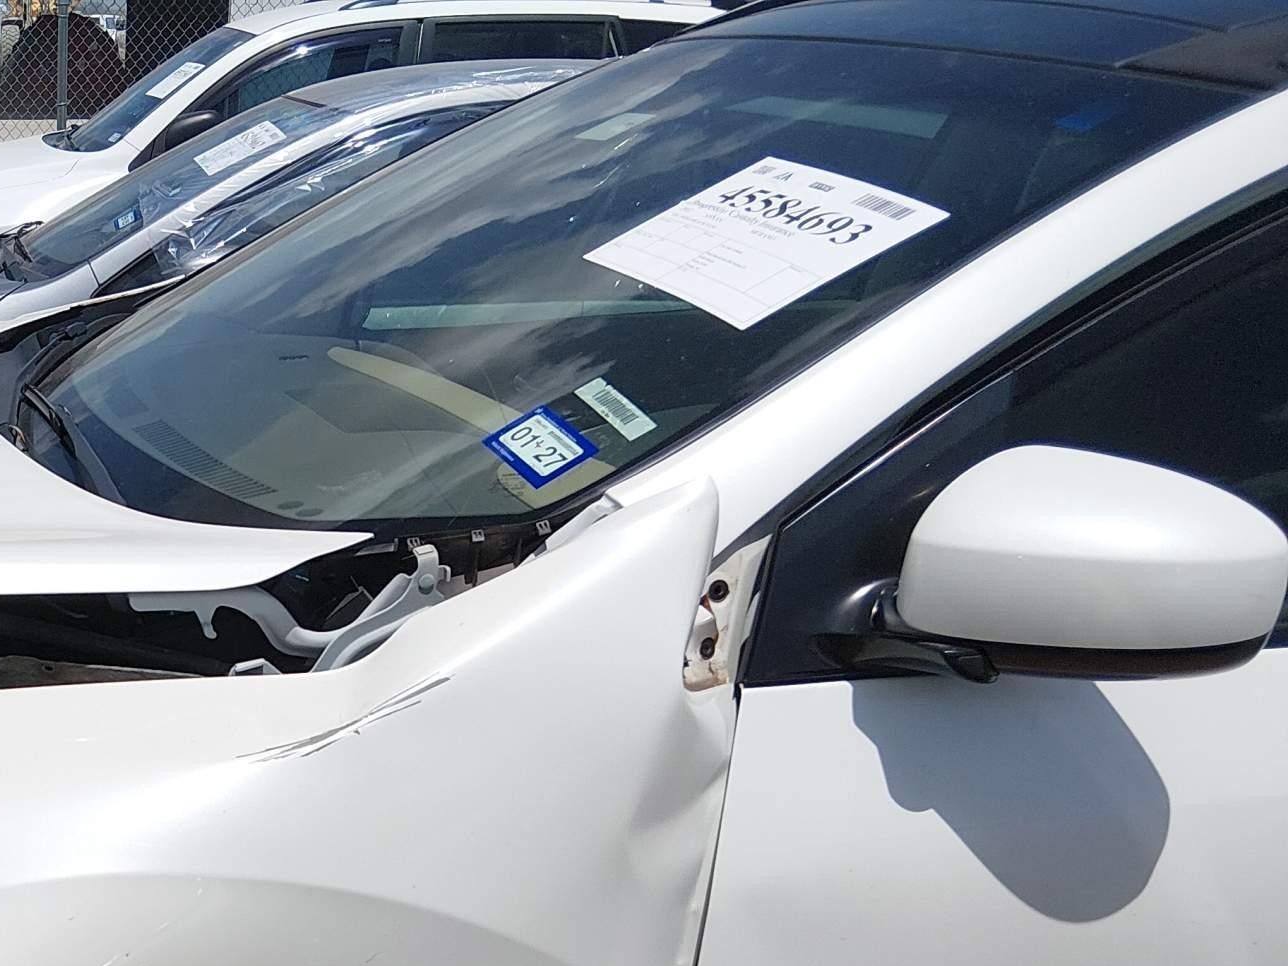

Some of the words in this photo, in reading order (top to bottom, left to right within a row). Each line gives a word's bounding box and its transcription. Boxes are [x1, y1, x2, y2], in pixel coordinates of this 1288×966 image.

[719, 186, 873, 245] 45584693
[511, 426, 540, 448] 01
[533, 446, 568, 468] 27
